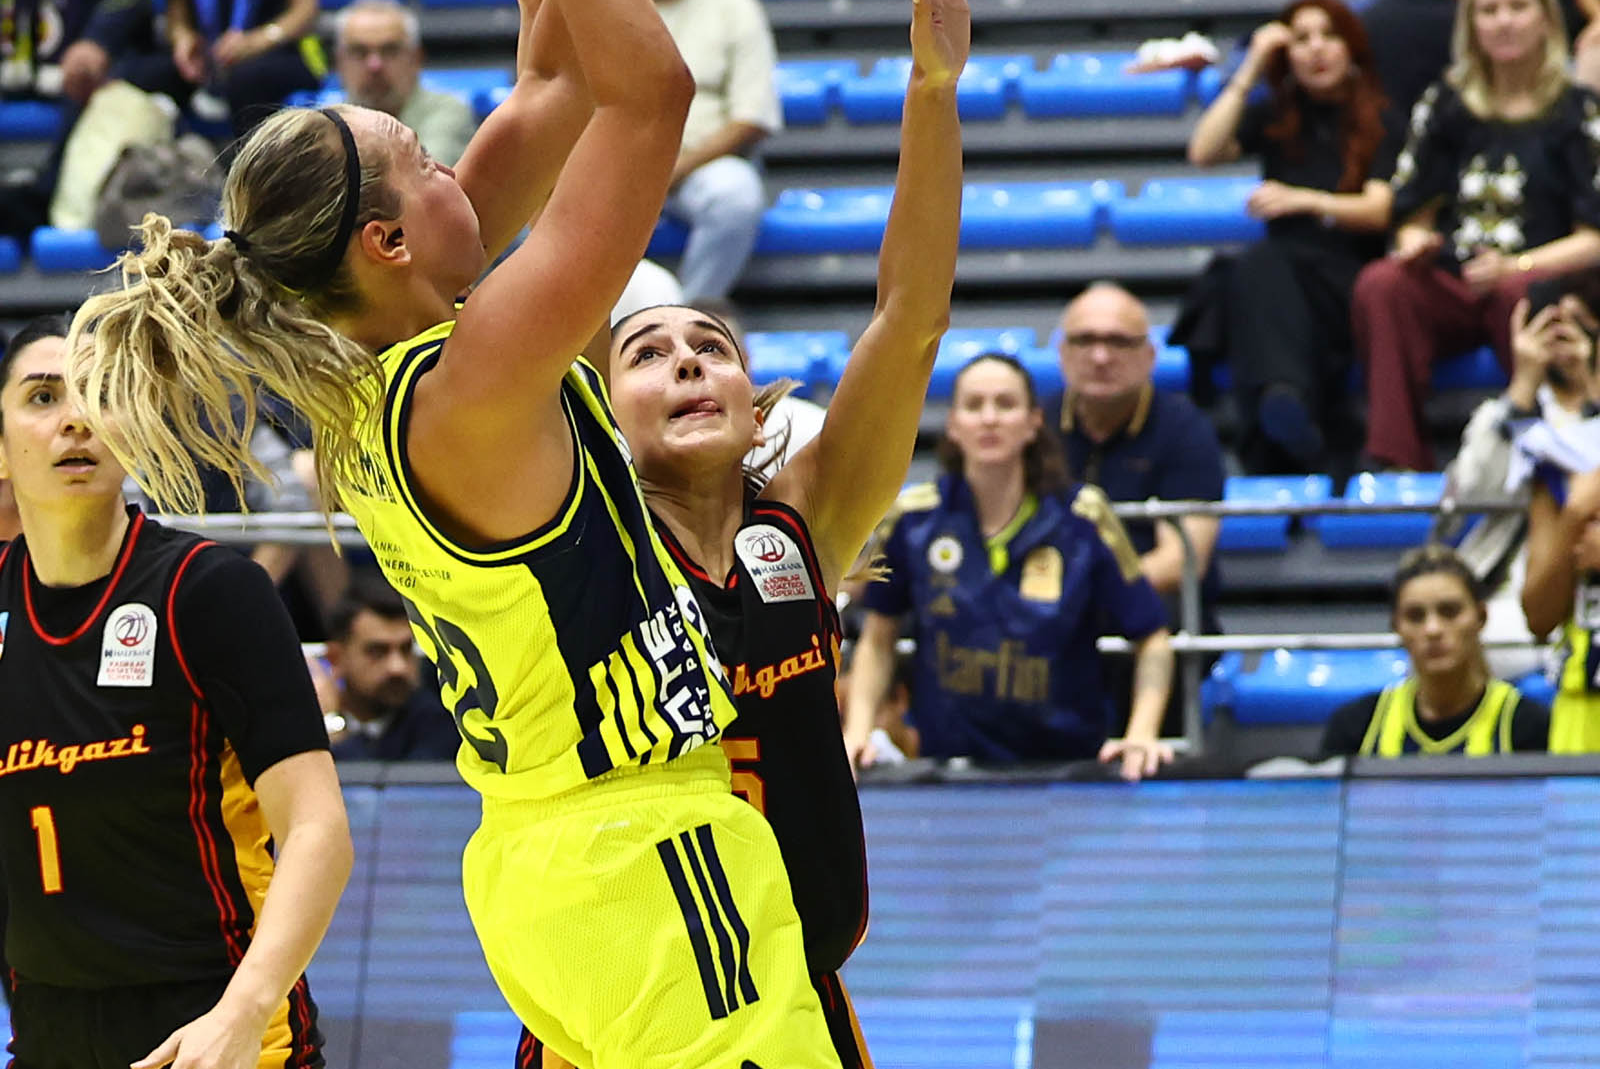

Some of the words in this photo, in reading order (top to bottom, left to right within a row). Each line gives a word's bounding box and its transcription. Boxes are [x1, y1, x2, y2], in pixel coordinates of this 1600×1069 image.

[665, 601, 698, 673] PARK
[935, 630, 1050, 704] tarfin
[29, 805, 64, 894] 1
